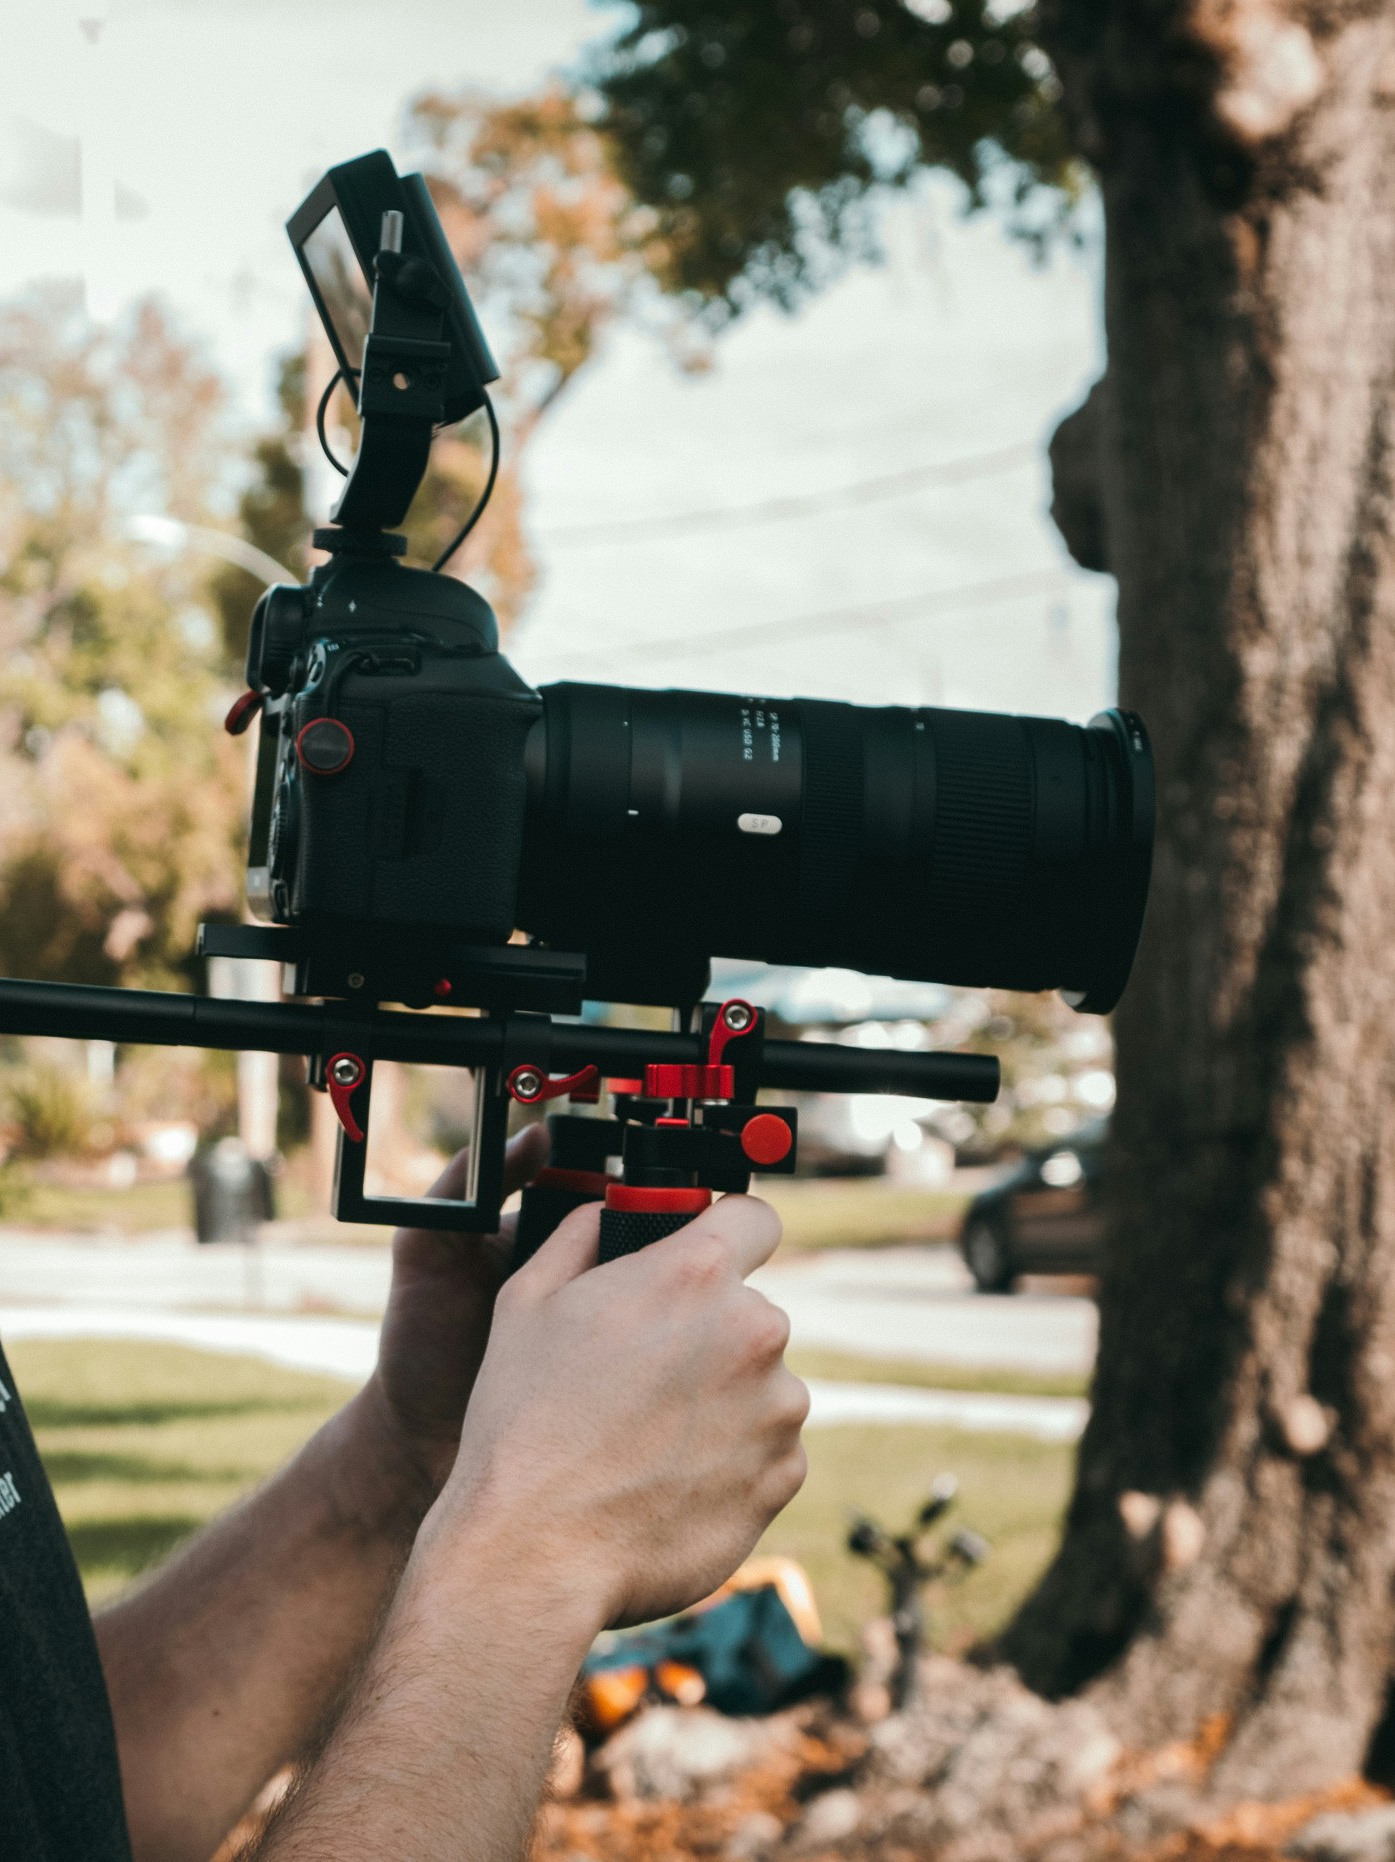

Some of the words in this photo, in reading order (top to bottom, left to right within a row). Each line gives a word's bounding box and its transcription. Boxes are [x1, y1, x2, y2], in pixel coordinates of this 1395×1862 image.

[743, 728, 753, 746] USD
[744, 747, 753, 760] G2
[751, 818, 769, 829] SP
